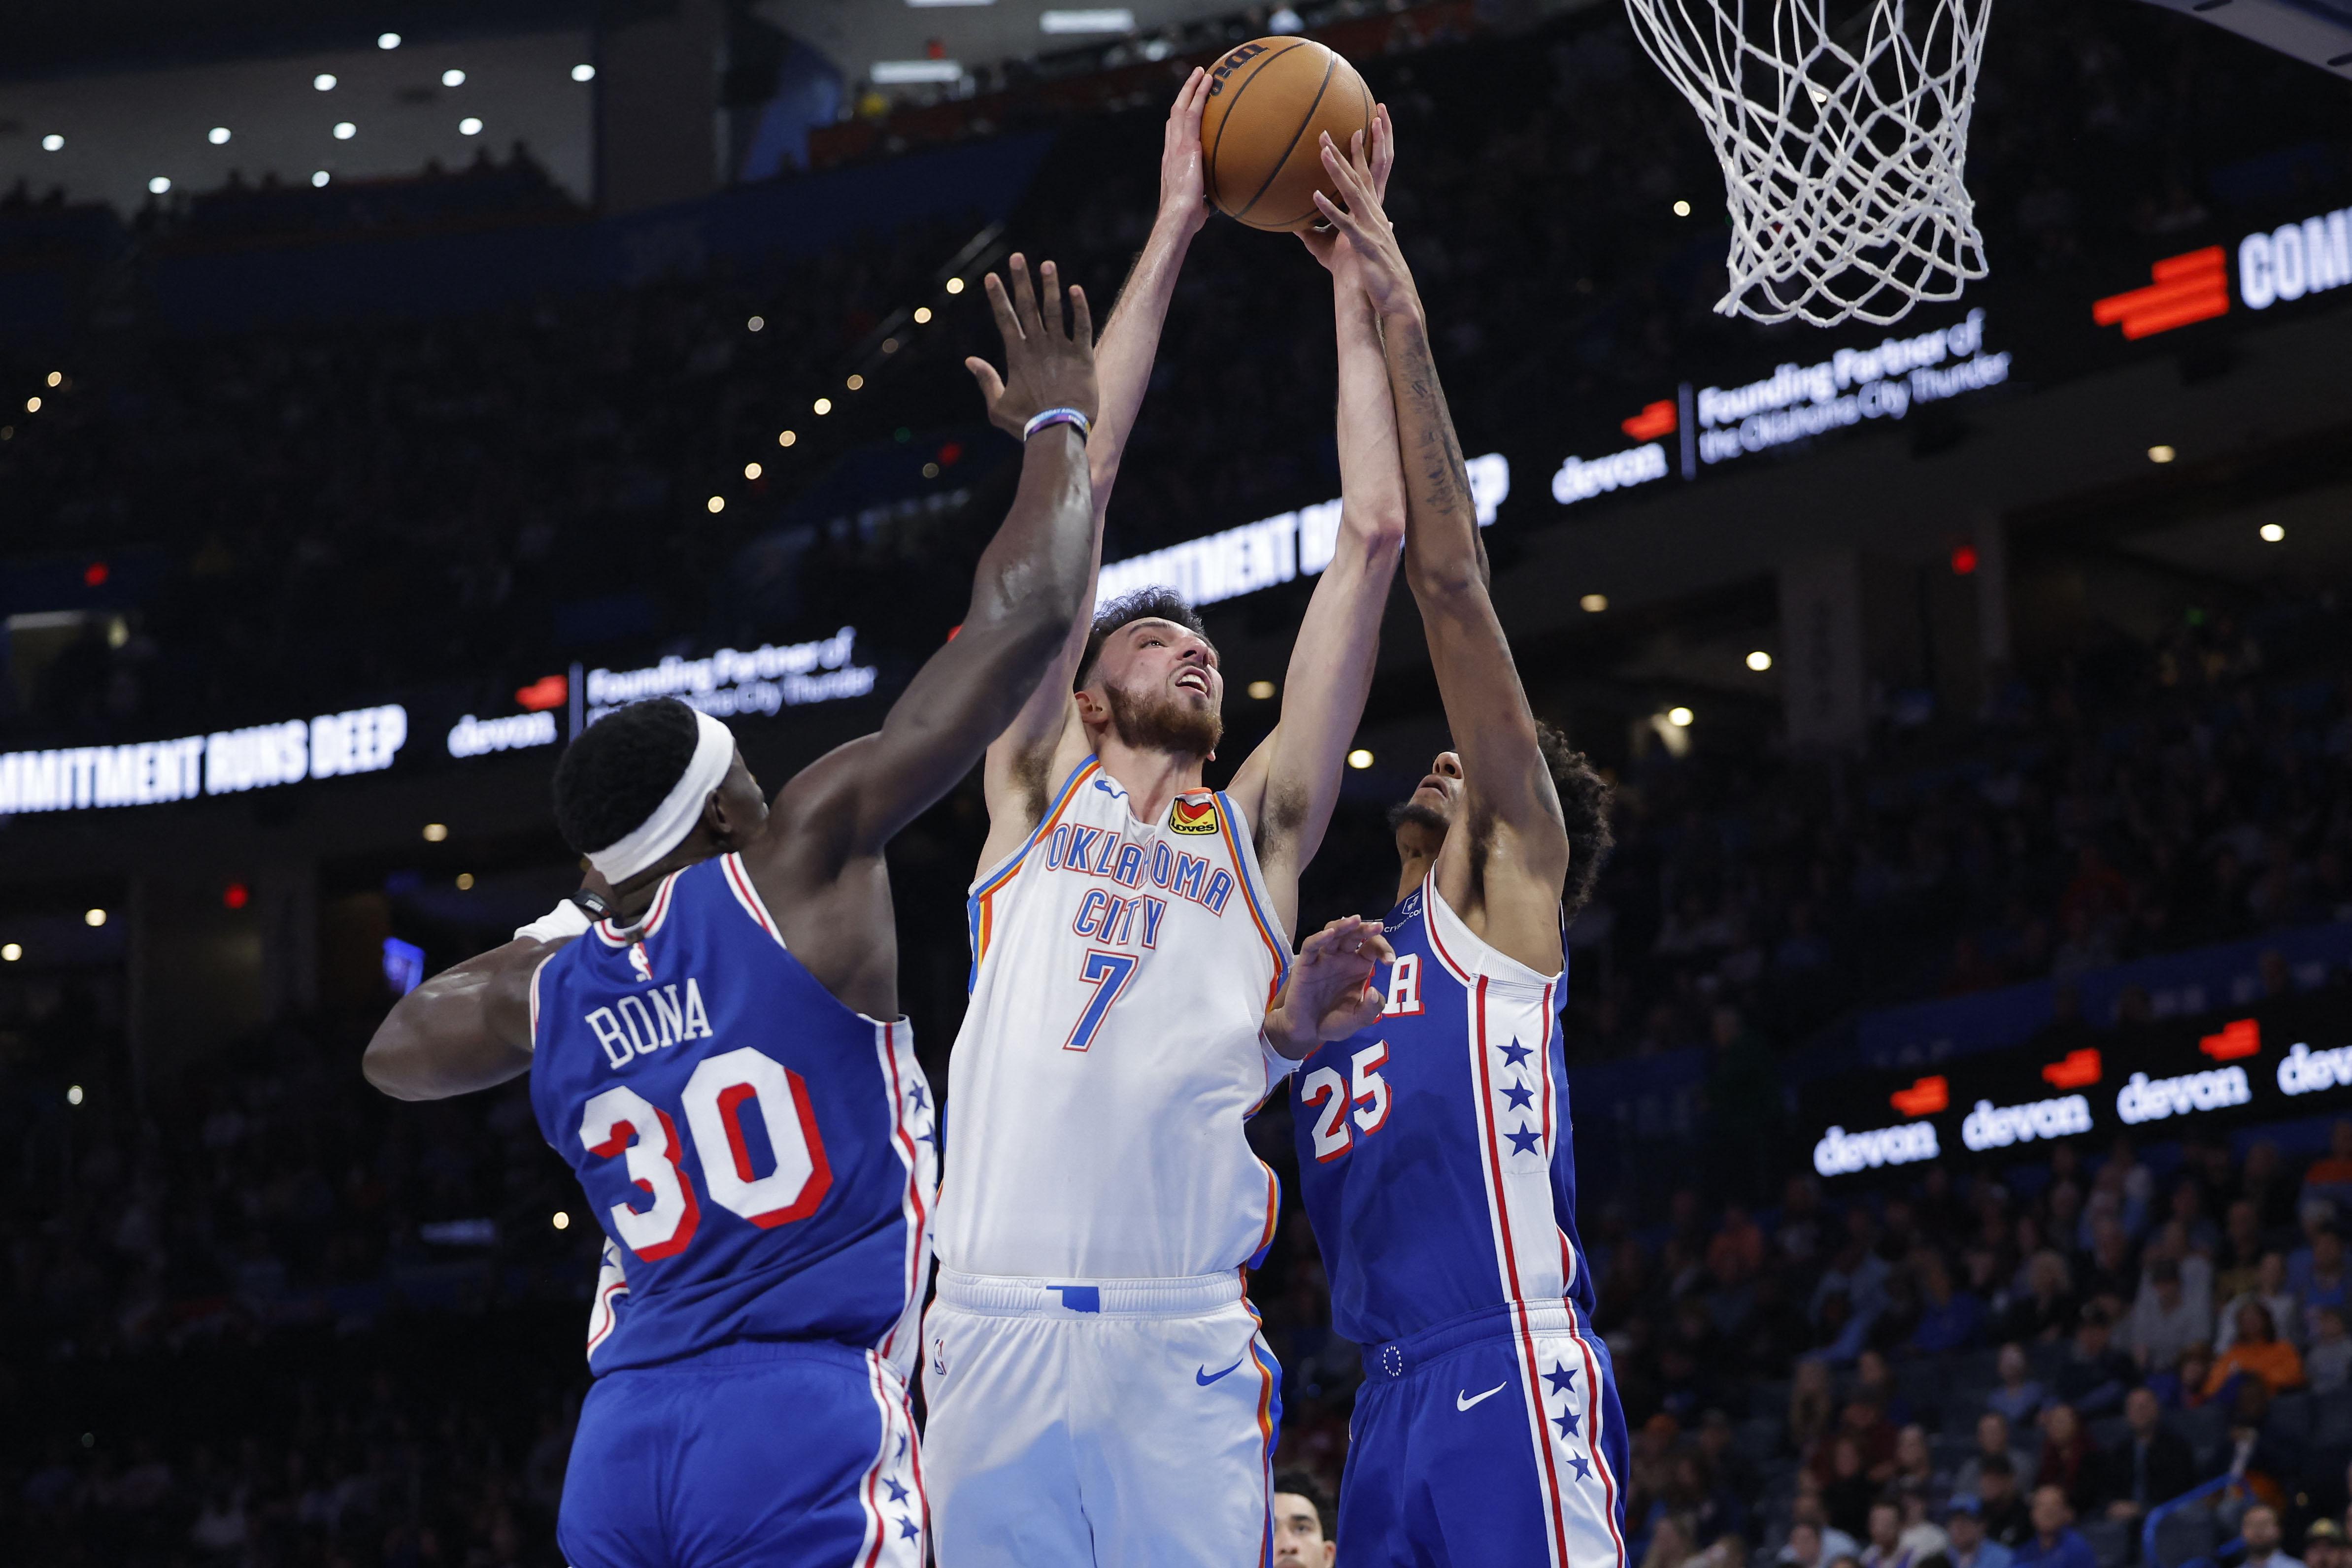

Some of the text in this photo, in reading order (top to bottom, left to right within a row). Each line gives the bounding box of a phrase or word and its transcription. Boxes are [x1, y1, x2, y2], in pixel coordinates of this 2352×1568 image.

[2239, 207, 2352, 309] COM
[1698, 308, 1984, 427] Founding Partner of
[1858, 378, 1911, 419] City
[1911, 351, 2011, 403] Thunder
[1552, 444, 1667, 504] devon
[587, 626, 856, 705] Founding Partner of
[205, 718, 309, 795] RUNS
[309, 704, 407, 779] DEEP
[448, 711, 557, 758] devon
[1045, 823, 1235, 918] OKLAHOMA
[1072, 888, 1167, 950] CITY
[585, 978, 713, 1069] BONA
[1062, 948, 1139, 1052] 7
[1301, 1039, 1392, 1164] 25
[2117, 1066, 2251, 1125] devon
[2277, 1042, 2352, 1096] dev
[579, 1046, 834, 1263] 30
[1814, 1121, 1940, 1176] devon
[1962, 1094, 2092, 1151] devon
